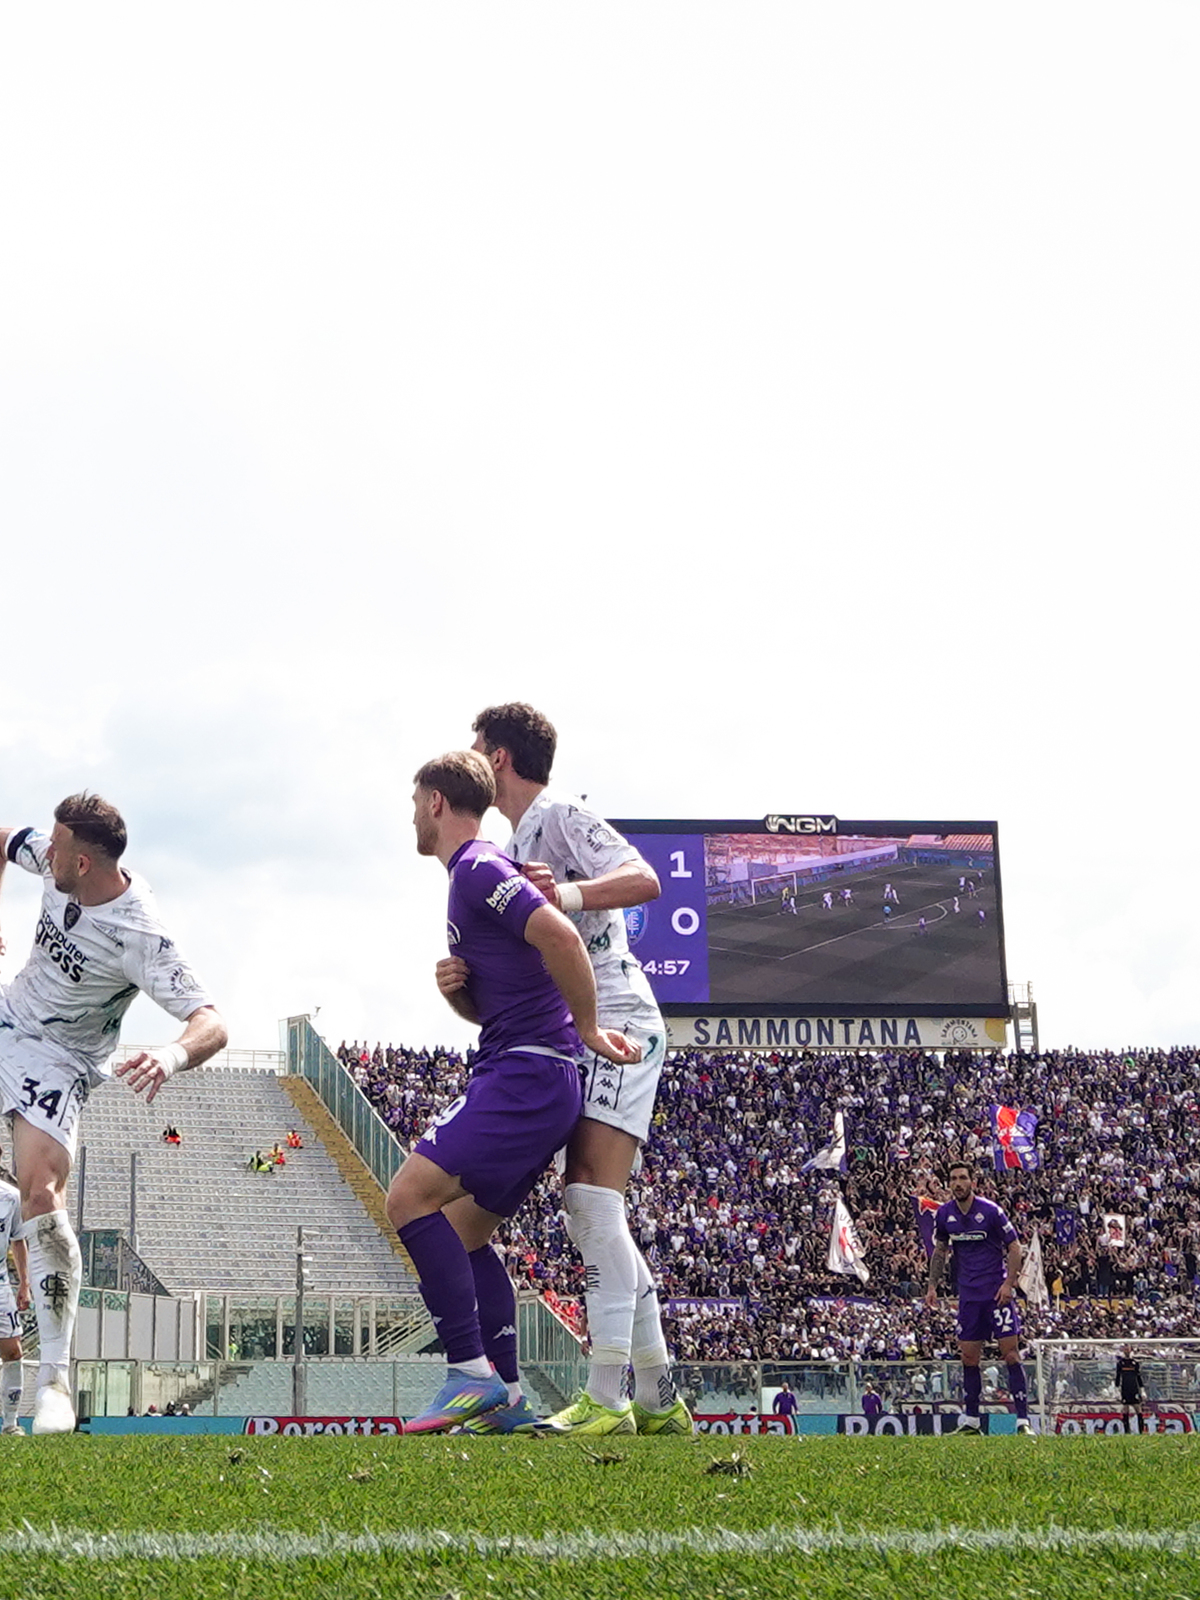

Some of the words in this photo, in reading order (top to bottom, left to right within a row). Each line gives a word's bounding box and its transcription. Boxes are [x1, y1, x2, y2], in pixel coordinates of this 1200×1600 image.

[670, 851, 692, 878] 1
[671, 907, 700, 935] 0
[640, 960, 691, 975] 4:57
[694, 1018, 921, 1046] SAMMONTANA
[20, 1077, 63, 1120] 34
[993, 1307, 1013, 1327] 32
